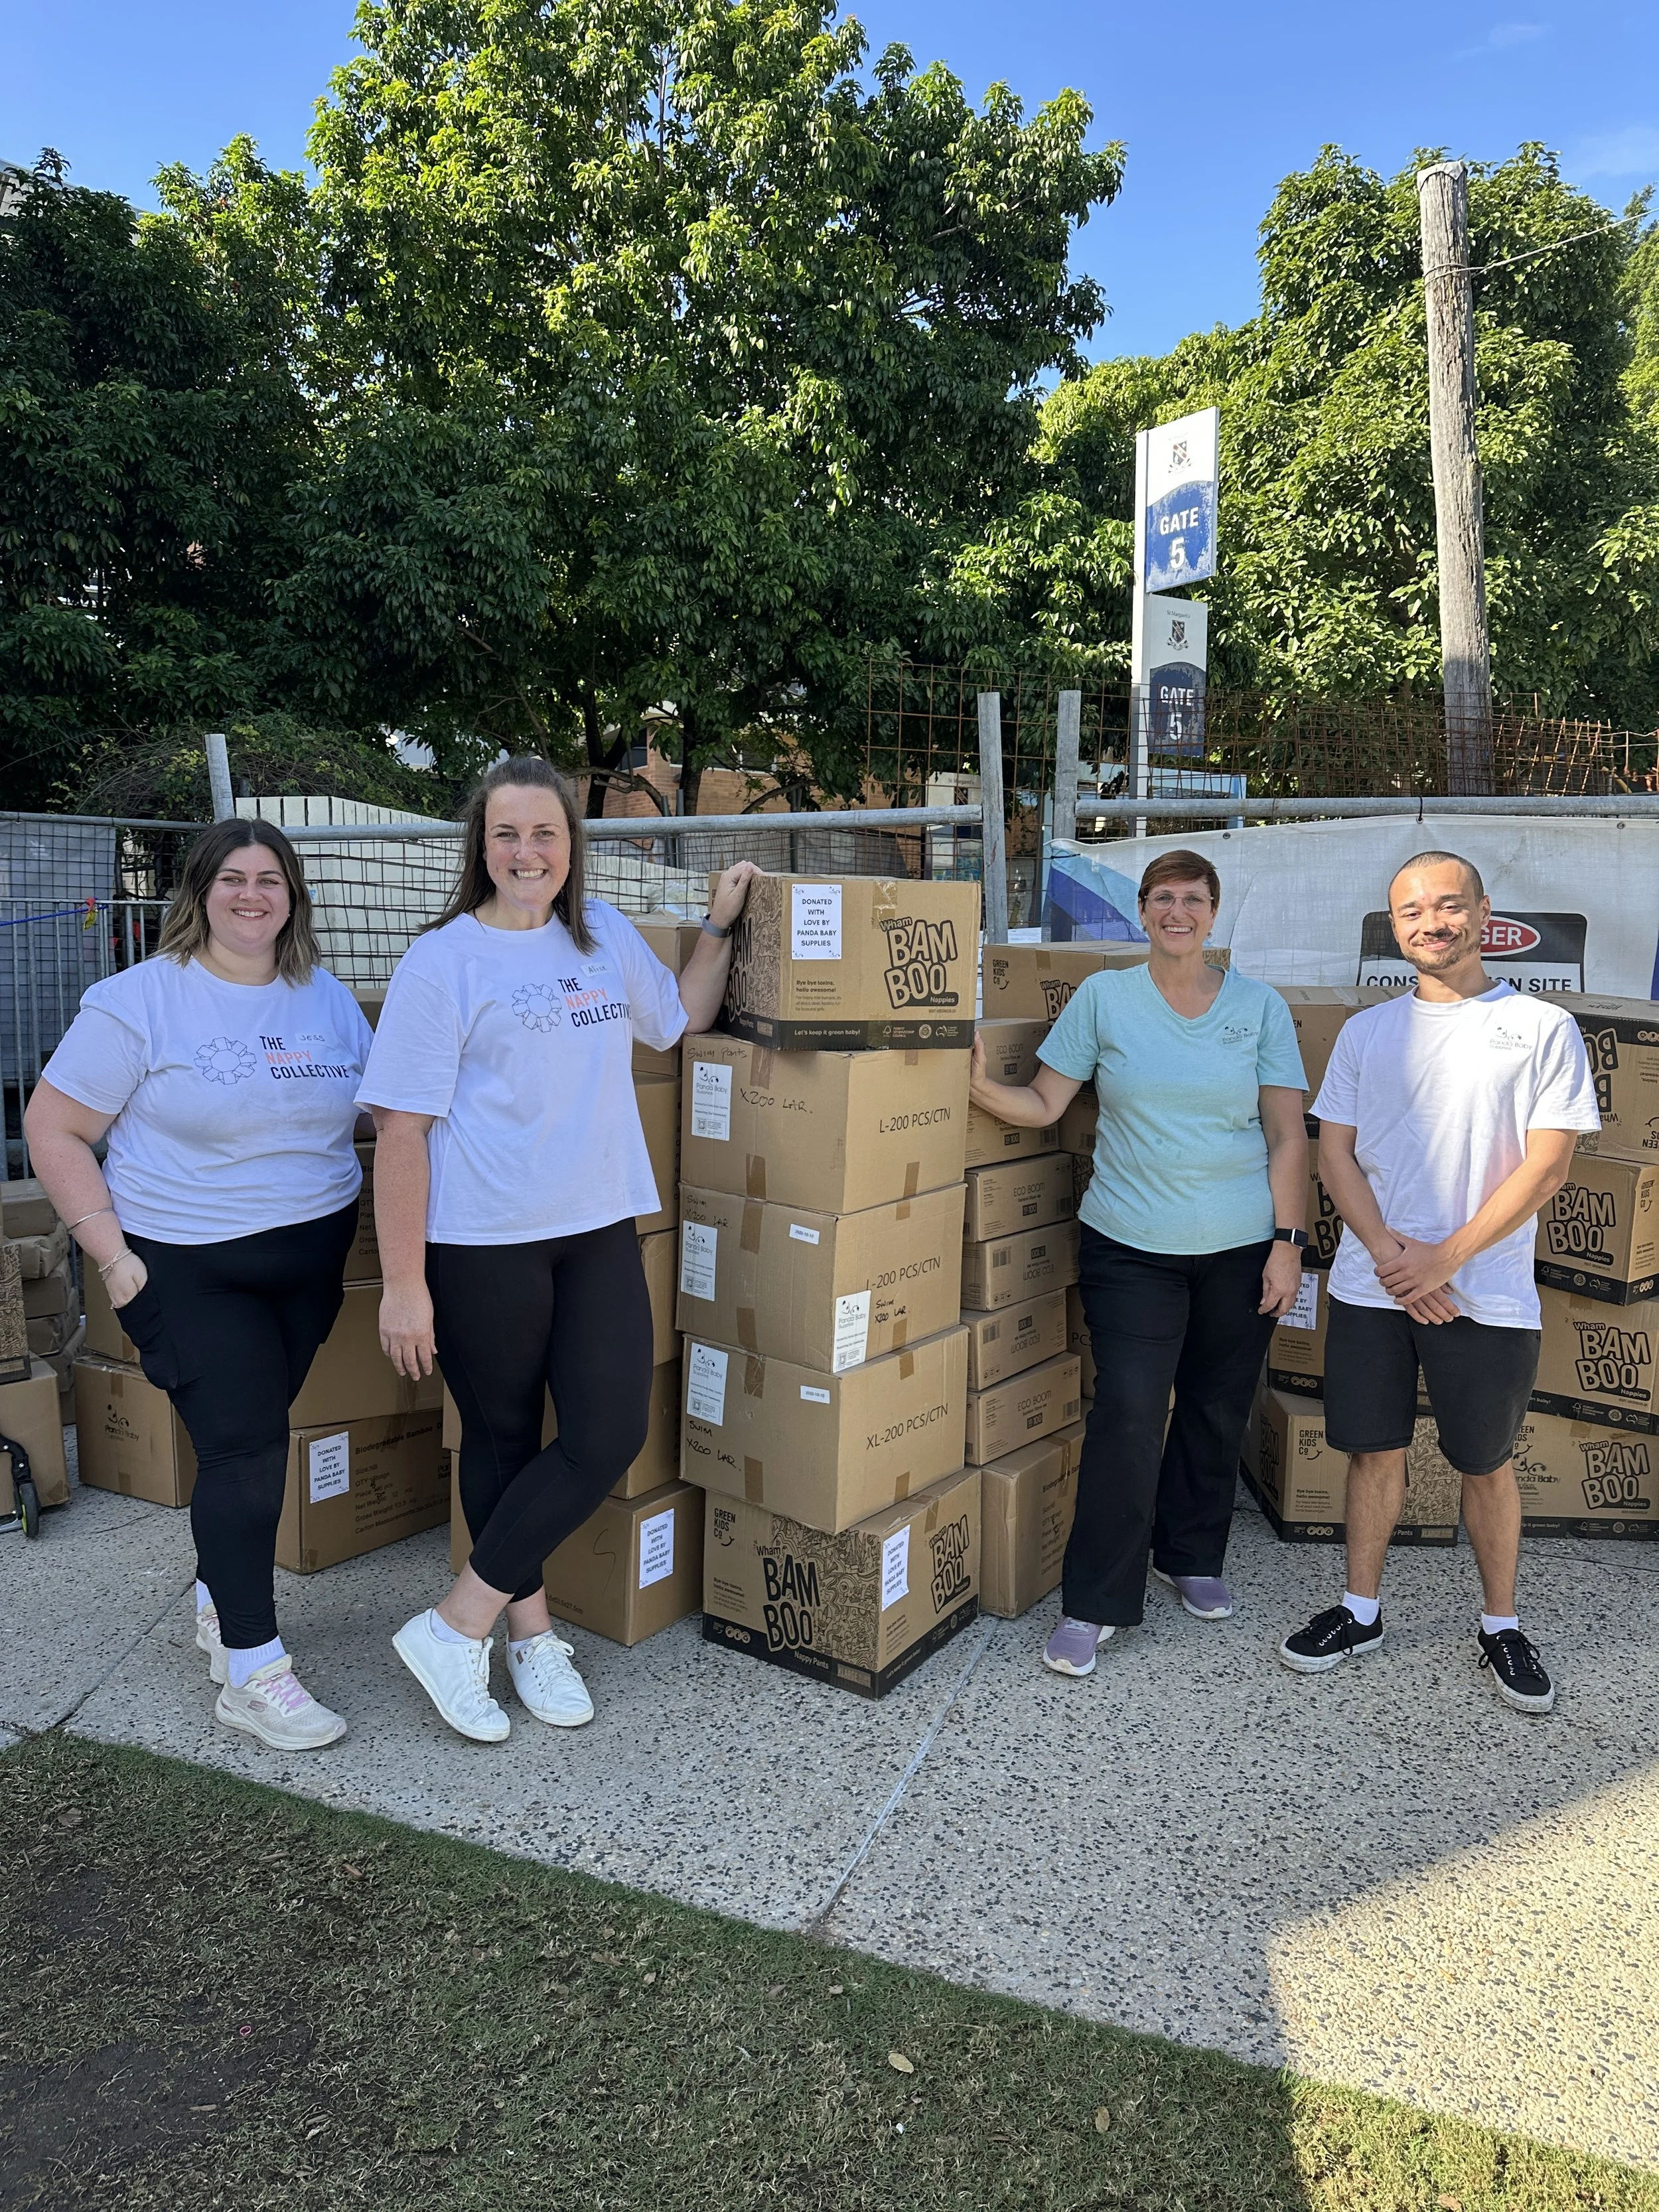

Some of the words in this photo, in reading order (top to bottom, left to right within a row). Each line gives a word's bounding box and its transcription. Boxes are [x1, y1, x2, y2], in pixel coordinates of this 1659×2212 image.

[1160, 507, 1198, 535] GATE
[1170, 536, 1185, 569] 5
[1161, 686, 1194, 706] GATE
[1169, 712, 1183, 741] 5
[880, 917, 912, 932] Wham
[887, 920, 958, 968] BAM
[993, 959, 1009, 968] GREEN
[557, 978, 583, 993] THE
[884, 960, 946, 1009] BOO
[1040, 980, 1060, 990] Wham
[1528, 978, 1572, 992] SITE
[565, 988, 609, 1010] NAPPY
[1045, 982, 1077, 1020] BA
[259, 1036, 286, 1050] THE
[265, 1051, 312, 1065] NAPPY
[687, 1047, 715, 1059] Swim
[270, 1065, 350, 1079] COLLECTIVE
[714, 1085, 727, 1094] Baby
[879, 1115, 909, 1133] L-200
[912, 1107, 950, 1128] PCS/CTN
[1013, 1186, 1025, 1197] ECO
[1641, 1189, 1650, 1199] KIDS
[1553, 1187, 1617, 1228] BAM
[1547, 1219, 1604, 1254] BOO
[685, 1241, 700, 1252] Panda
[700, 1246, 713, 1256] Baby
[1587, 1252, 1611, 1263] Nappies
[900, 1256, 940, 1281] PCS/CTN
[1573, 1321, 1606, 1330] Wham
[1579, 1327, 1651, 1364] BAM
[693, 1363, 709, 1374] Panda
[710, 1369, 723, 1379] Baby
[1575, 1358, 1638, 1391] BOO
[1621, 1388, 1646, 1398] Nappies
[1018, 1398, 1031, 1412] ECO
[105, 1425, 124, 1436] Panda
[124, 1430, 139, 1441] Baby
[866, 1423, 904, 1450] XL-200
[906, 1402, 948, 1433] PCS/CTN
[356, 1434, 405, 1455] Biodegradable
[406, 1426, 433, 1439] Bamboo
[1299, 1430, 1323, 1439] GREEN
[1299, 1438, 1317, 1447] KIDS
[1579, 1441, 1609, 1452] Wham
[318, 1445, 342, 1456] DONATED
[1299, 1447, 1309, 1455] Co
[1586, 1442, 1651, 1479] BAM
[319, 1464, 332, 1473] LOVE
[315, 1474, 331, 1483] PANDA
[332, 1469, 345, 1477] BABY
[1538, 1475, 1559, 1483] Baby
[318, 1479, 341, 1490] SUPPLIES
[1581, 1473, 1639, 1510] BOO
[356, 1503, 366, 1511] Net
[356, 1513, 372, 1522] Gross
[714, 1508, 736, 1523] GREEN
[356, 1524, 374, 1534] Carton
[647, 1523, 668, 1536] DONATED
[714, 1518, 729, 1532] KIDS
[651, 1534, 663, 1544] WITH
[713, 1528, 723, 1540] Co
[648, 1545, 660, 1554] LOVE
[757, 1546, 781, 1556] Wham
[888, 1541, 904, 1556] DONATED
[932, 1514, 970, 1577] BAM
[644, 1556, 658, 1566] PANDA
[659, 1549, 670, 1558] BABY
[891, 1553, 900, 1563] WITH
[646, 1560, 667, 1574] SUPPLIES
[888, 1564, 897, 1575] LOVE
[763, 1554, 820, 1607] BAM
[885, 1576, 896, 1586] PANDA
[896, 1568, 904, 1578] BABY
[887, 1579, 902, 1595] SUPPLIES
[931, 1555, 964, 1614] BOO
[763, 1601, 813, 1649] BOO
[794, 1651, 813, 1664] Nappy
[813, 1658, 829, 1670] Pants
